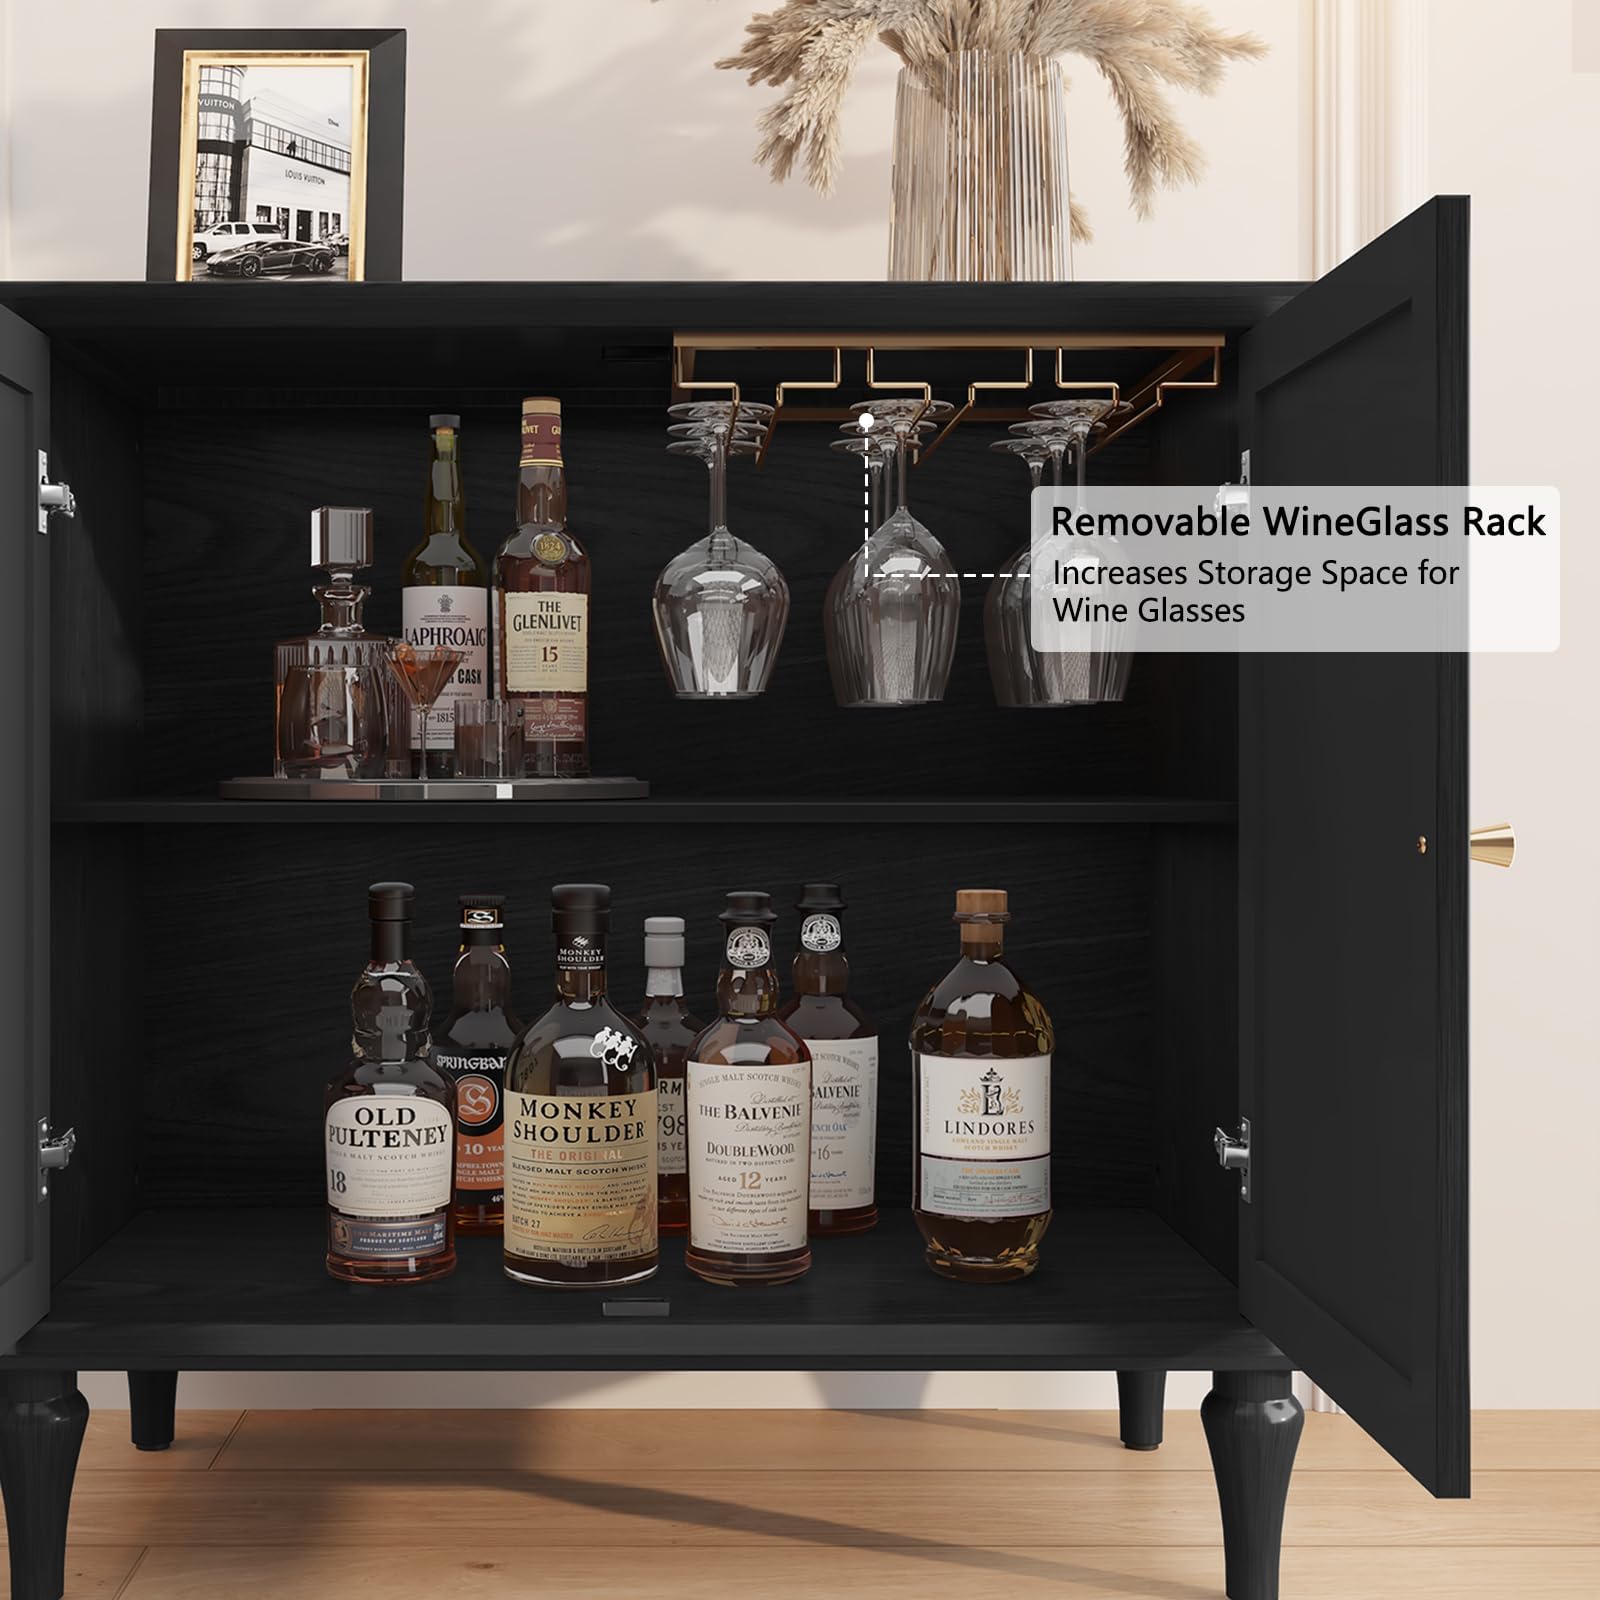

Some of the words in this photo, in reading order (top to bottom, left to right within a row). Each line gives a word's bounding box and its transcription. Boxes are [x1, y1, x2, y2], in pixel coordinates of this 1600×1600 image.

[285, 169, 302, 179] LOUIS
[304, 173, 326, 185] VUITTON
[540, 542, 560, 551] 1824
[537, 601, 561, 612] THE
[513, 614, 582, 632] GLENLIVET
[542, 646, 558, 662] 15
[458, 669, 481, 684] CASK
[437, 713, 455, 723] 1815
[722, 1073, 744, 1081] MALT
[747, 1073, 779, 1081] SCOTCH
[355, 1107, 416, 1126] OLD
[520, 1098, 636, 1120] MONKEY
[700, 1104, 721, 1118] THE
[725, 1103, 802, 1120] BALVENIE
[329, 1124, 447, 1148] PULTENEY
[514, 1120, 646, 1143] SHOULDER
[944, 1120, 1035, 1136] LINDORES
[464, 1143, 484, 1155] 10
[531, 1149, 553, 1160] THE
[559, 1149, 623, 1161] ORIGINAL
[818, 1144, 830, 1160] 16
[512, 1161, 543, 1174] BLENDED
[576, 1167, 619, 1176] SCOTCH
[621, 1163, 647, 1172] WHISKY
[331, 1168, 347, 1194] 18
[739, 1171, 762, 1190] 12
[512, 1214, 528, 1226] BATCH
[531, 1218, 541, 1228] 27
[369, 1230, 412, 1238] MARITIME
[415, 1227, 432, 1235] MALT
